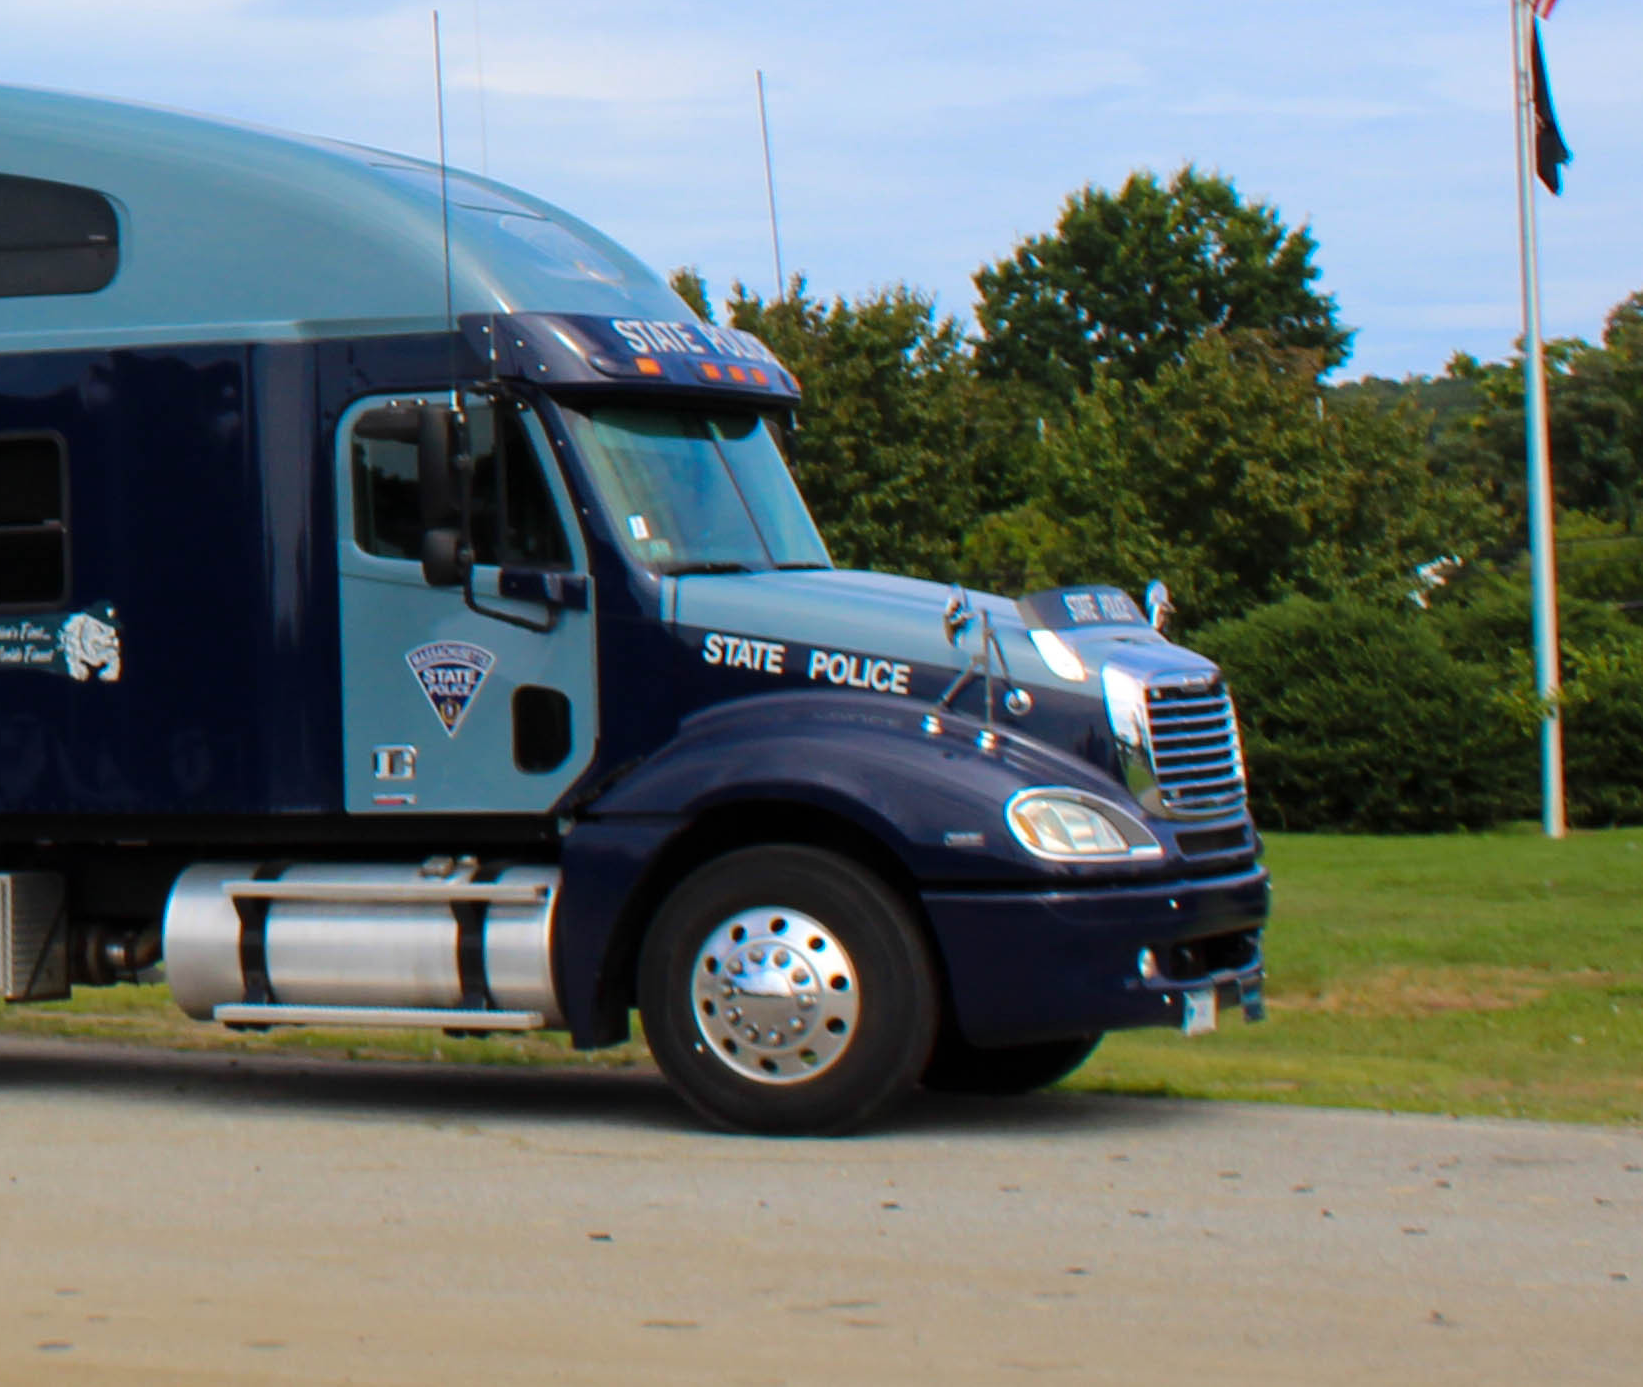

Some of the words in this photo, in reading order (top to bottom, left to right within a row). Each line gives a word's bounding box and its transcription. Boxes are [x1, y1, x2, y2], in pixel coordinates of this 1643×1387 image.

[610, 317, 707, 354] STATE
[422, 667, 477, 685] STATE
[702, 632, 787, 674] STATE
[809, 647, 911, 695] POLICE
